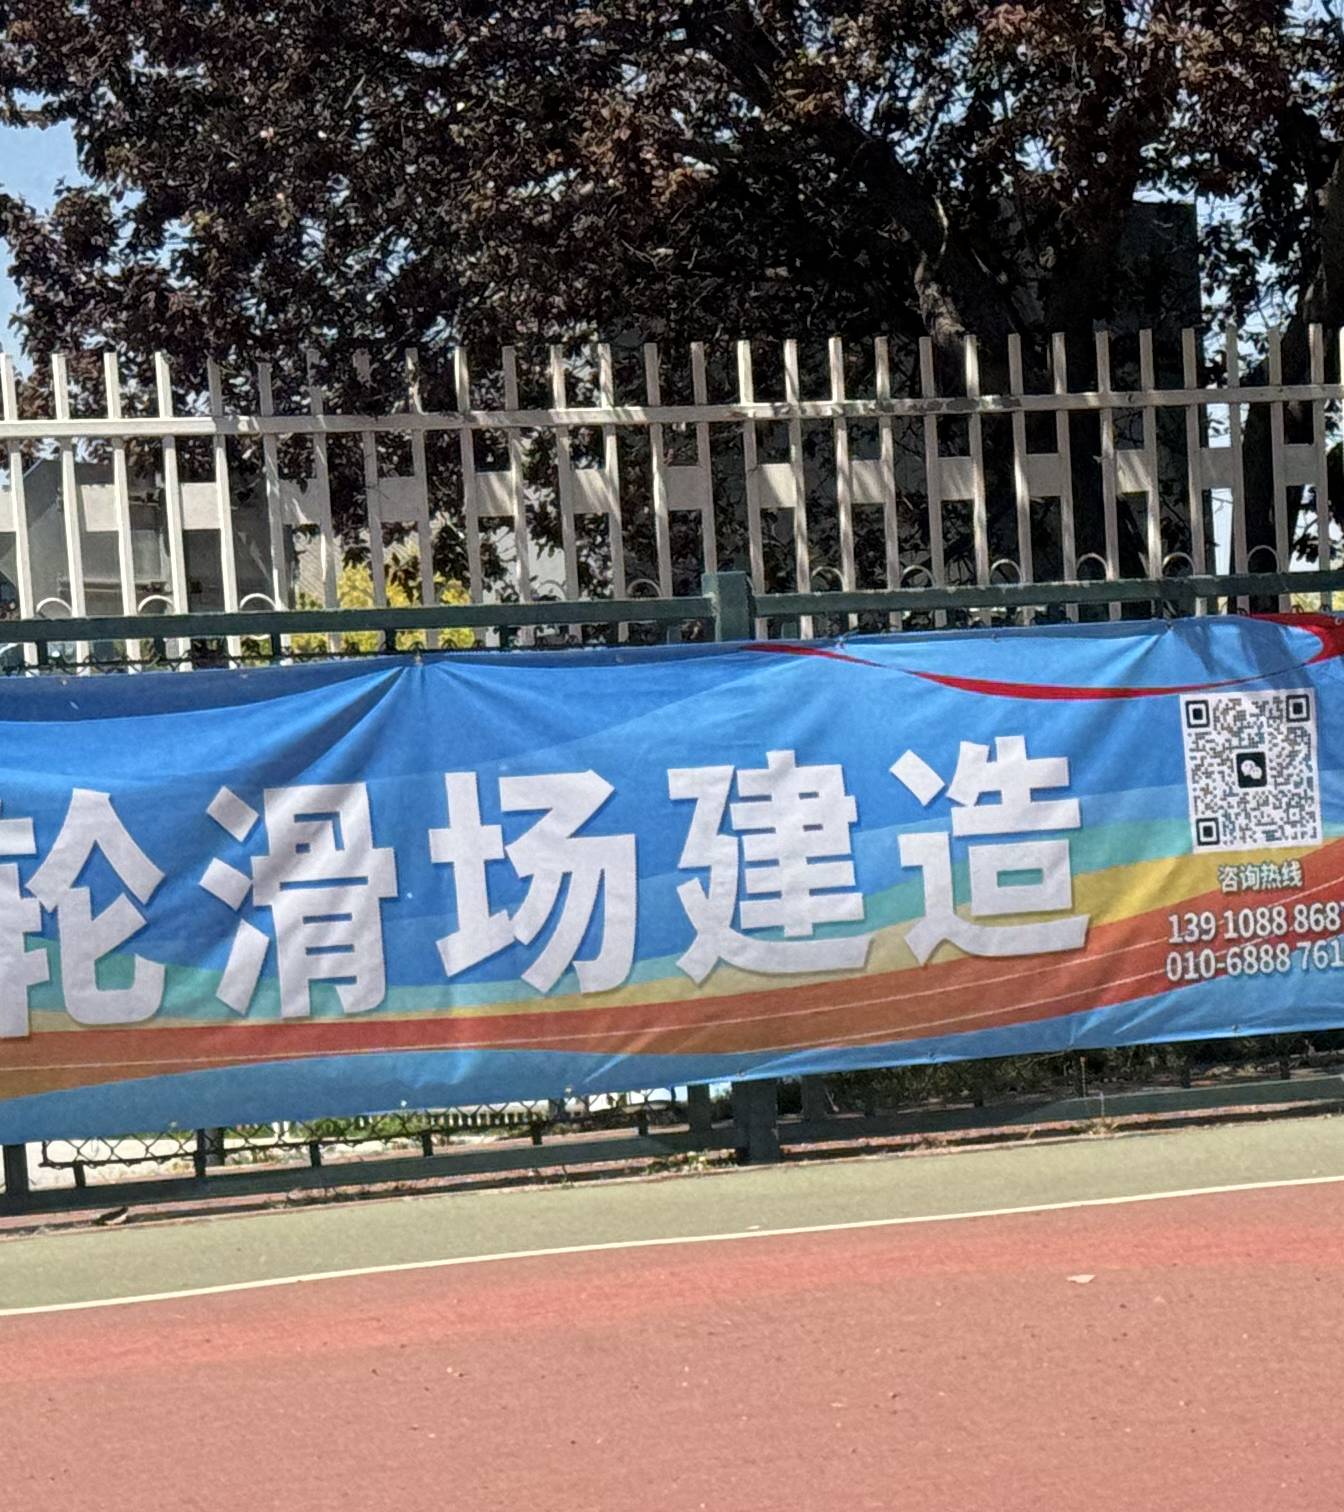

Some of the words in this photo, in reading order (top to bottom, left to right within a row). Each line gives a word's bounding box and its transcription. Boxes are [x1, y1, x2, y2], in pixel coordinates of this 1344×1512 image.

[1218, 860, 1303, 893] 咨询热线
[1168, 911, 1216, 944] 139
[1223, 906, 1287, 940] 1088
[1166, 943, 1291, 981] 010-6888
